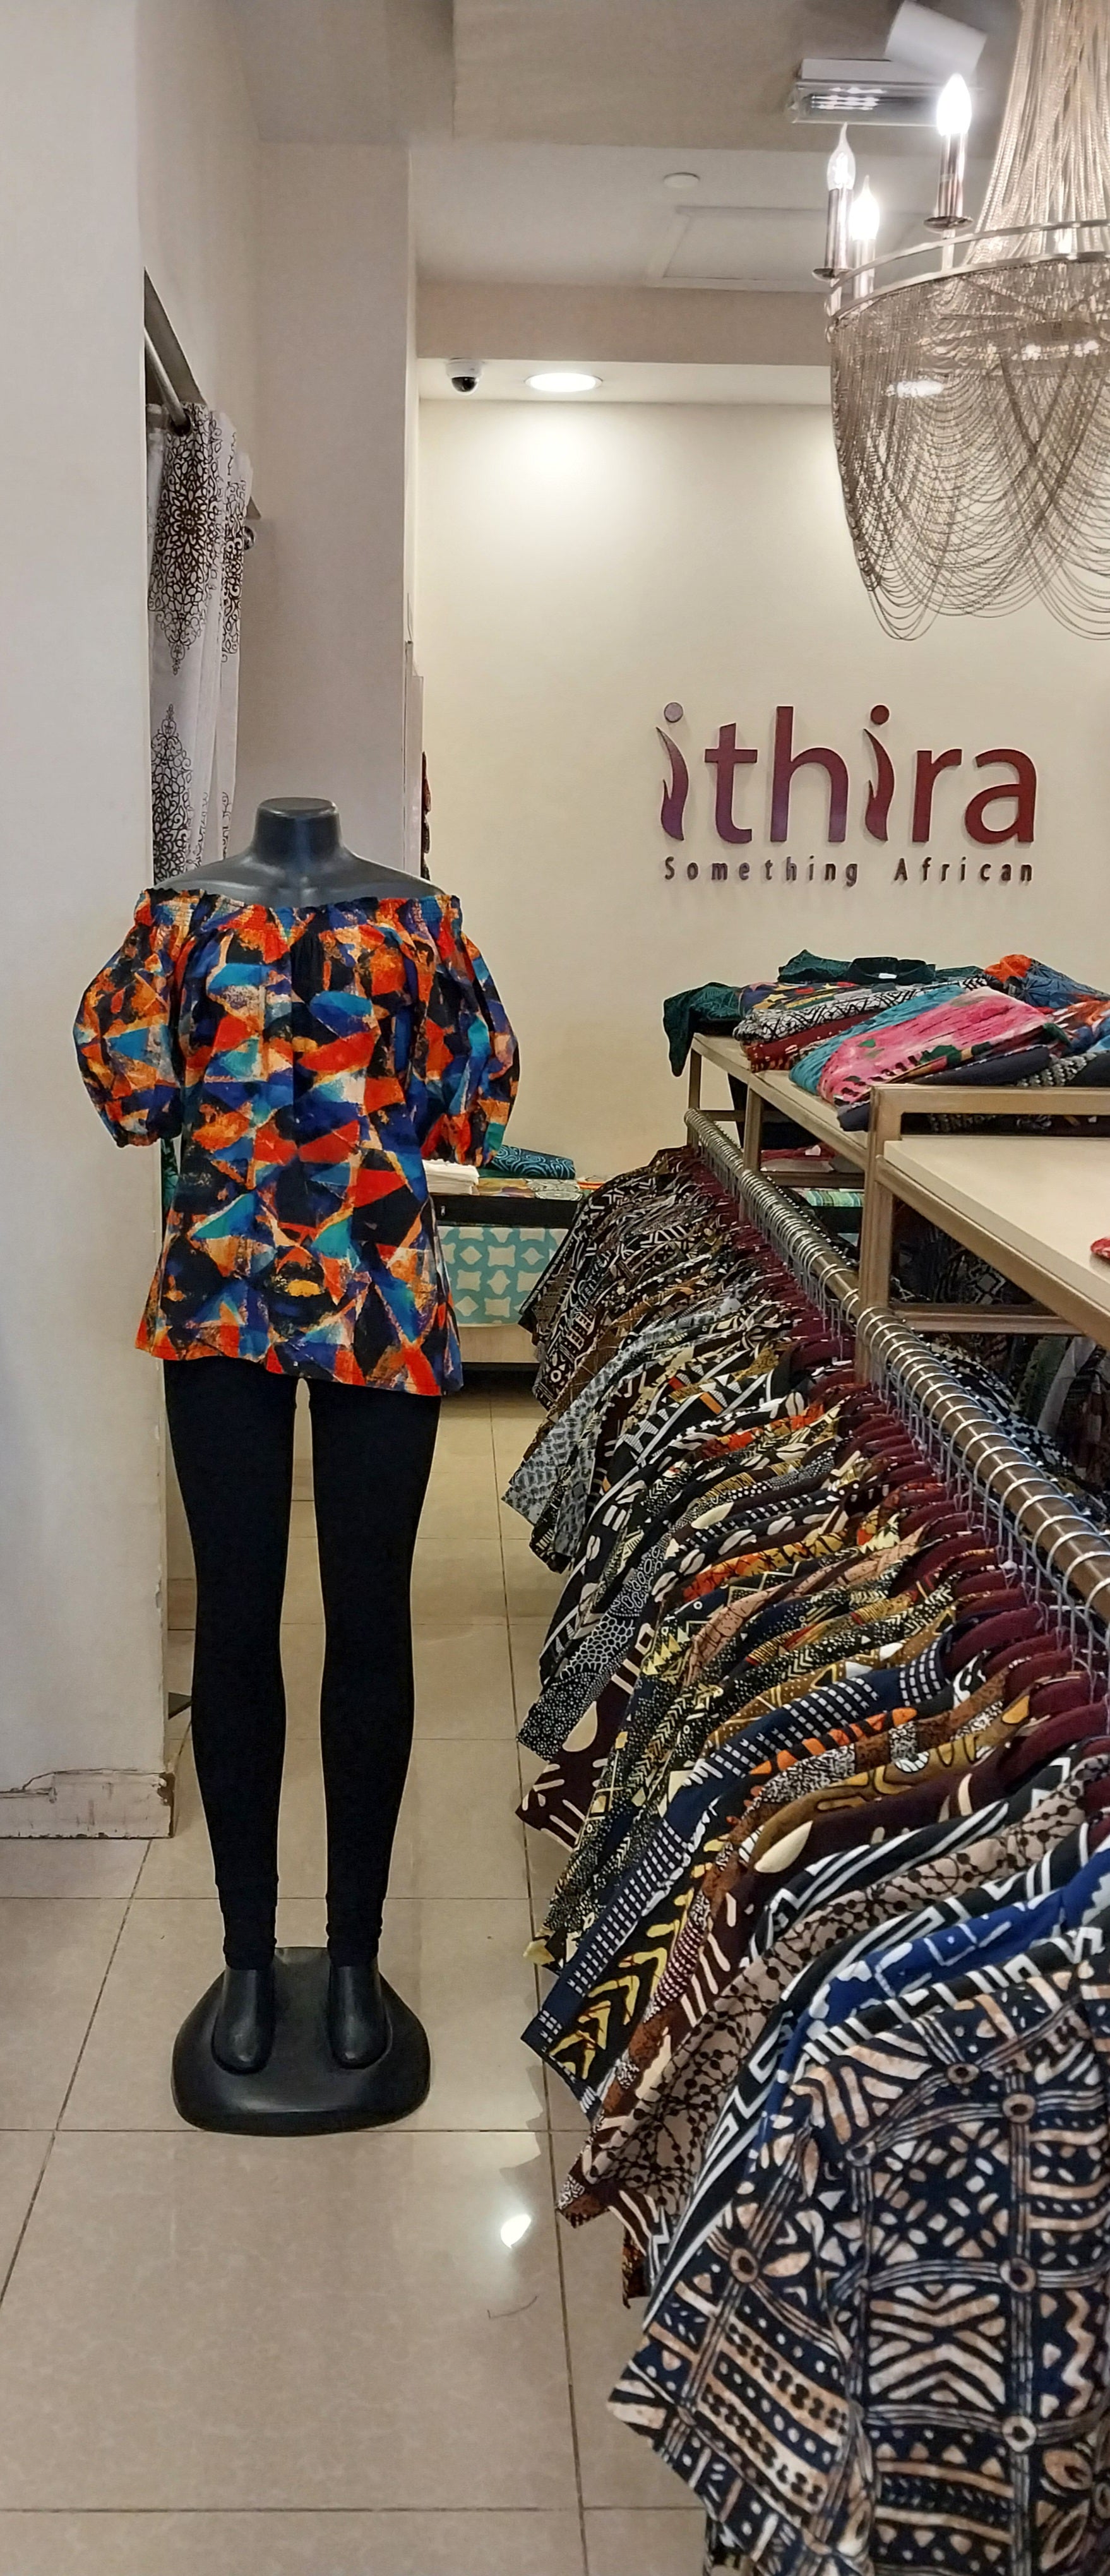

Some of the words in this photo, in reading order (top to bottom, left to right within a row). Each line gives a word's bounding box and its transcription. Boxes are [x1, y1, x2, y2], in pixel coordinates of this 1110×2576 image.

[656, 701, 1037, 844] ithira
[664, 856, 859, 887] Something
[893, 857, 1034, 881] African
